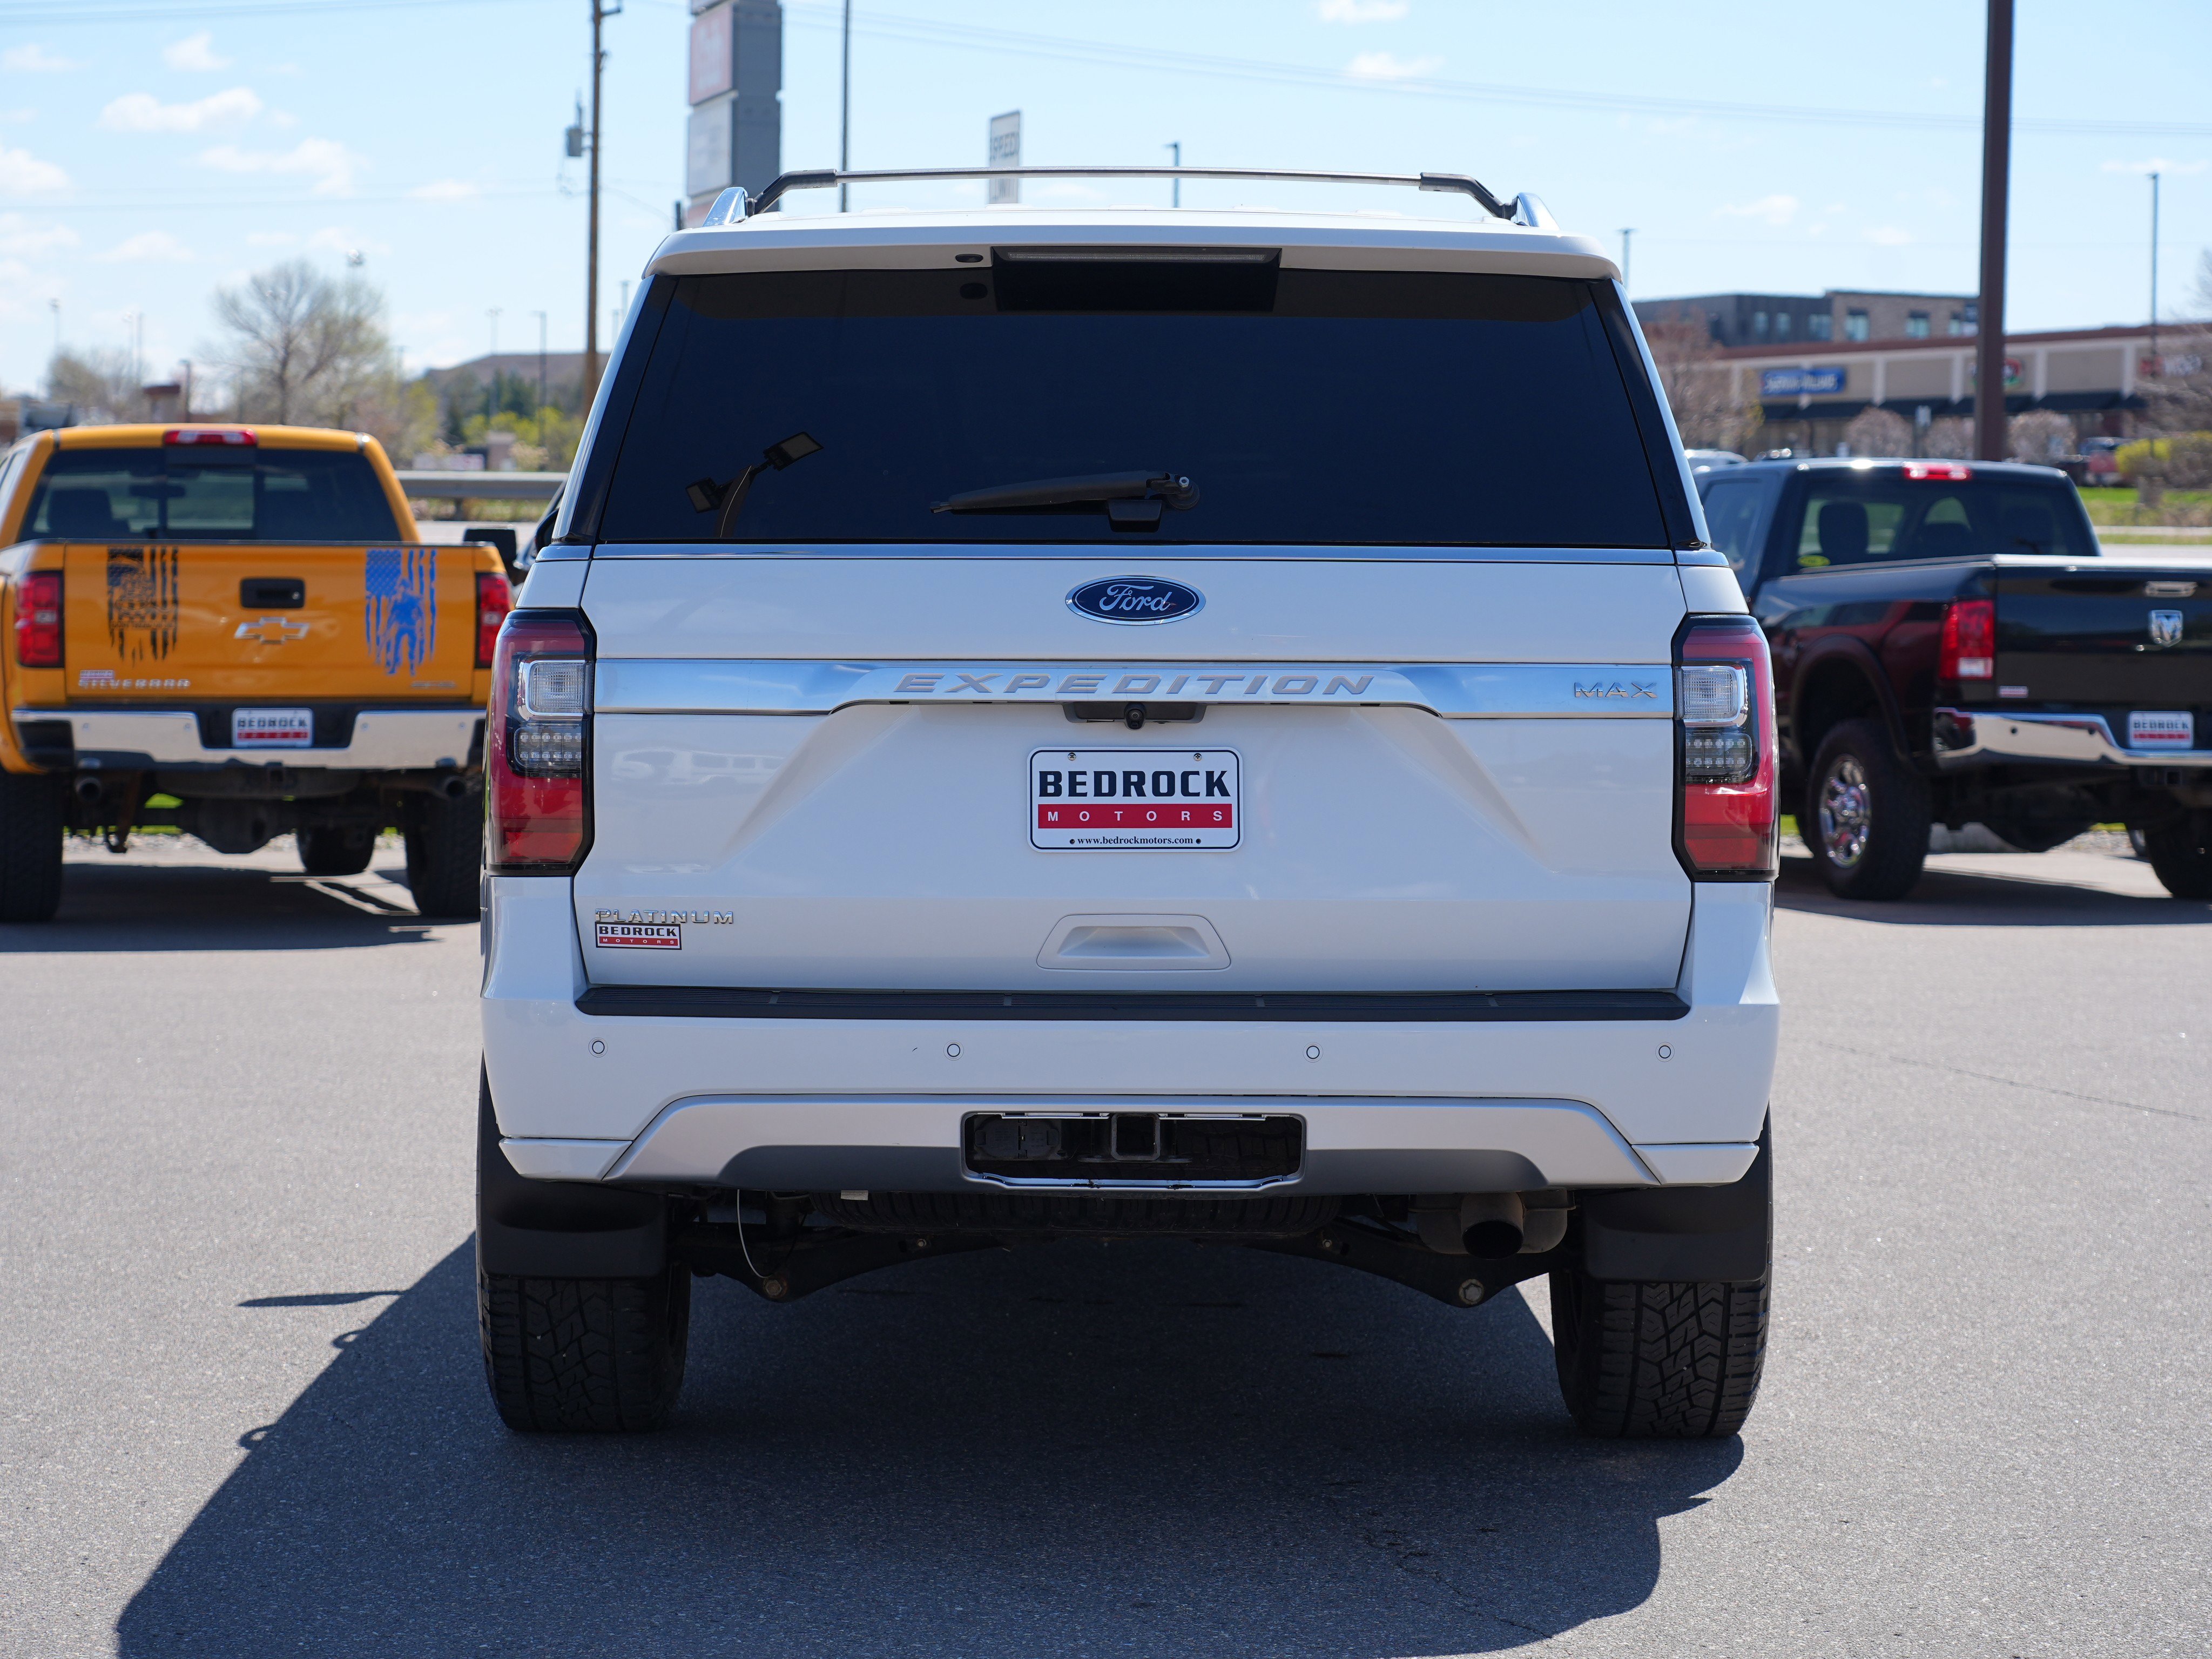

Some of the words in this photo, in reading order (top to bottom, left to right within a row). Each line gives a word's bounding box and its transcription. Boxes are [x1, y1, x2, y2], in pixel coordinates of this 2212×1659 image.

[1099, 584, 1172, 611] Ford
[893, 673, 1375, 695] EXPEDITION
[1574, 682, 1658, 698] MAX
[1038, 771, 1231, 797] BEDROCK
[1048, 811, 1223, 821] MOTORS
[595, 908, 733, 924] PLATINUM
[599, 926, 677, 936] BEDROCK
